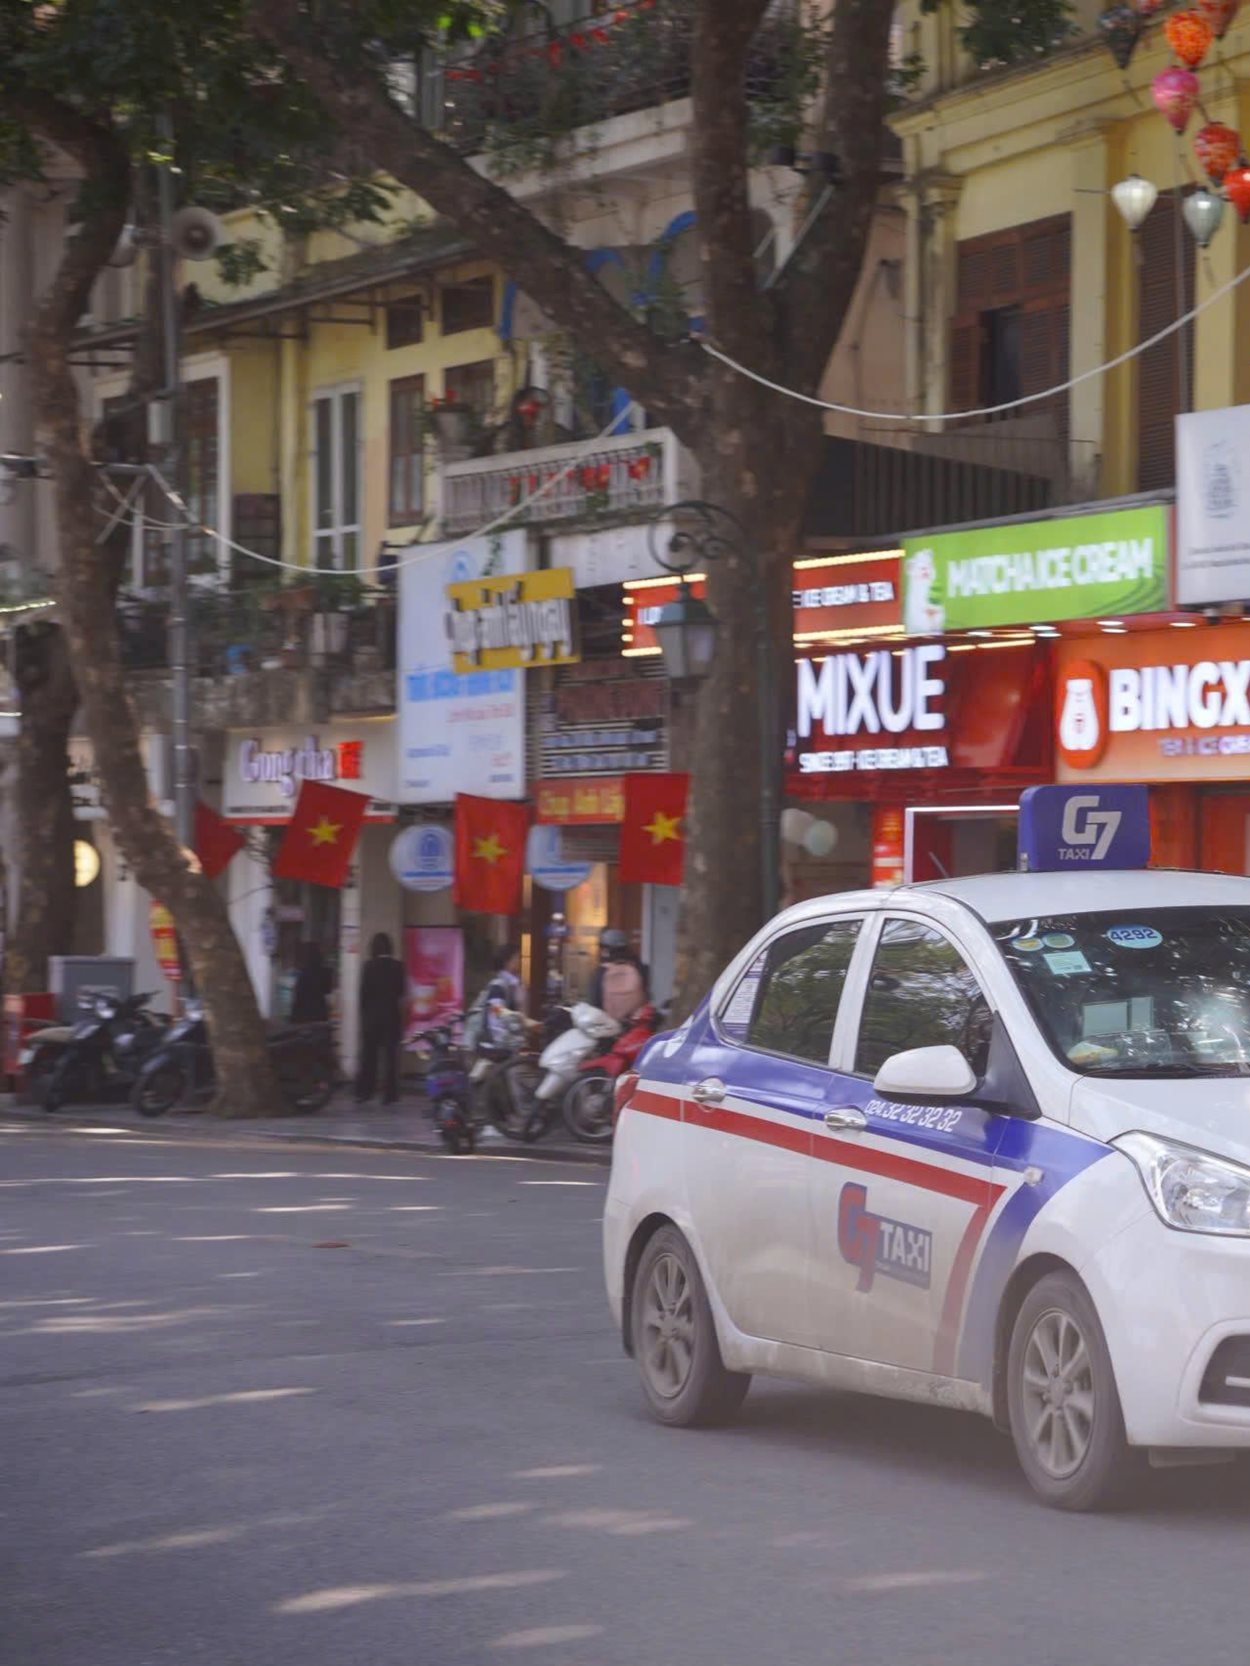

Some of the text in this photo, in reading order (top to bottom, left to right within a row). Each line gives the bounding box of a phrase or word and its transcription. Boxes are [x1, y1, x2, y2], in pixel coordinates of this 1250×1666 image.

[797, 644, 946, 738] MIXUE
[1061, 795, 1123, 860] G7
[1057, 848, 1091, 860] TAXI
[1109, 927, 1159, 942] 4292
[880, 1221, 931, 1273] TAXI
